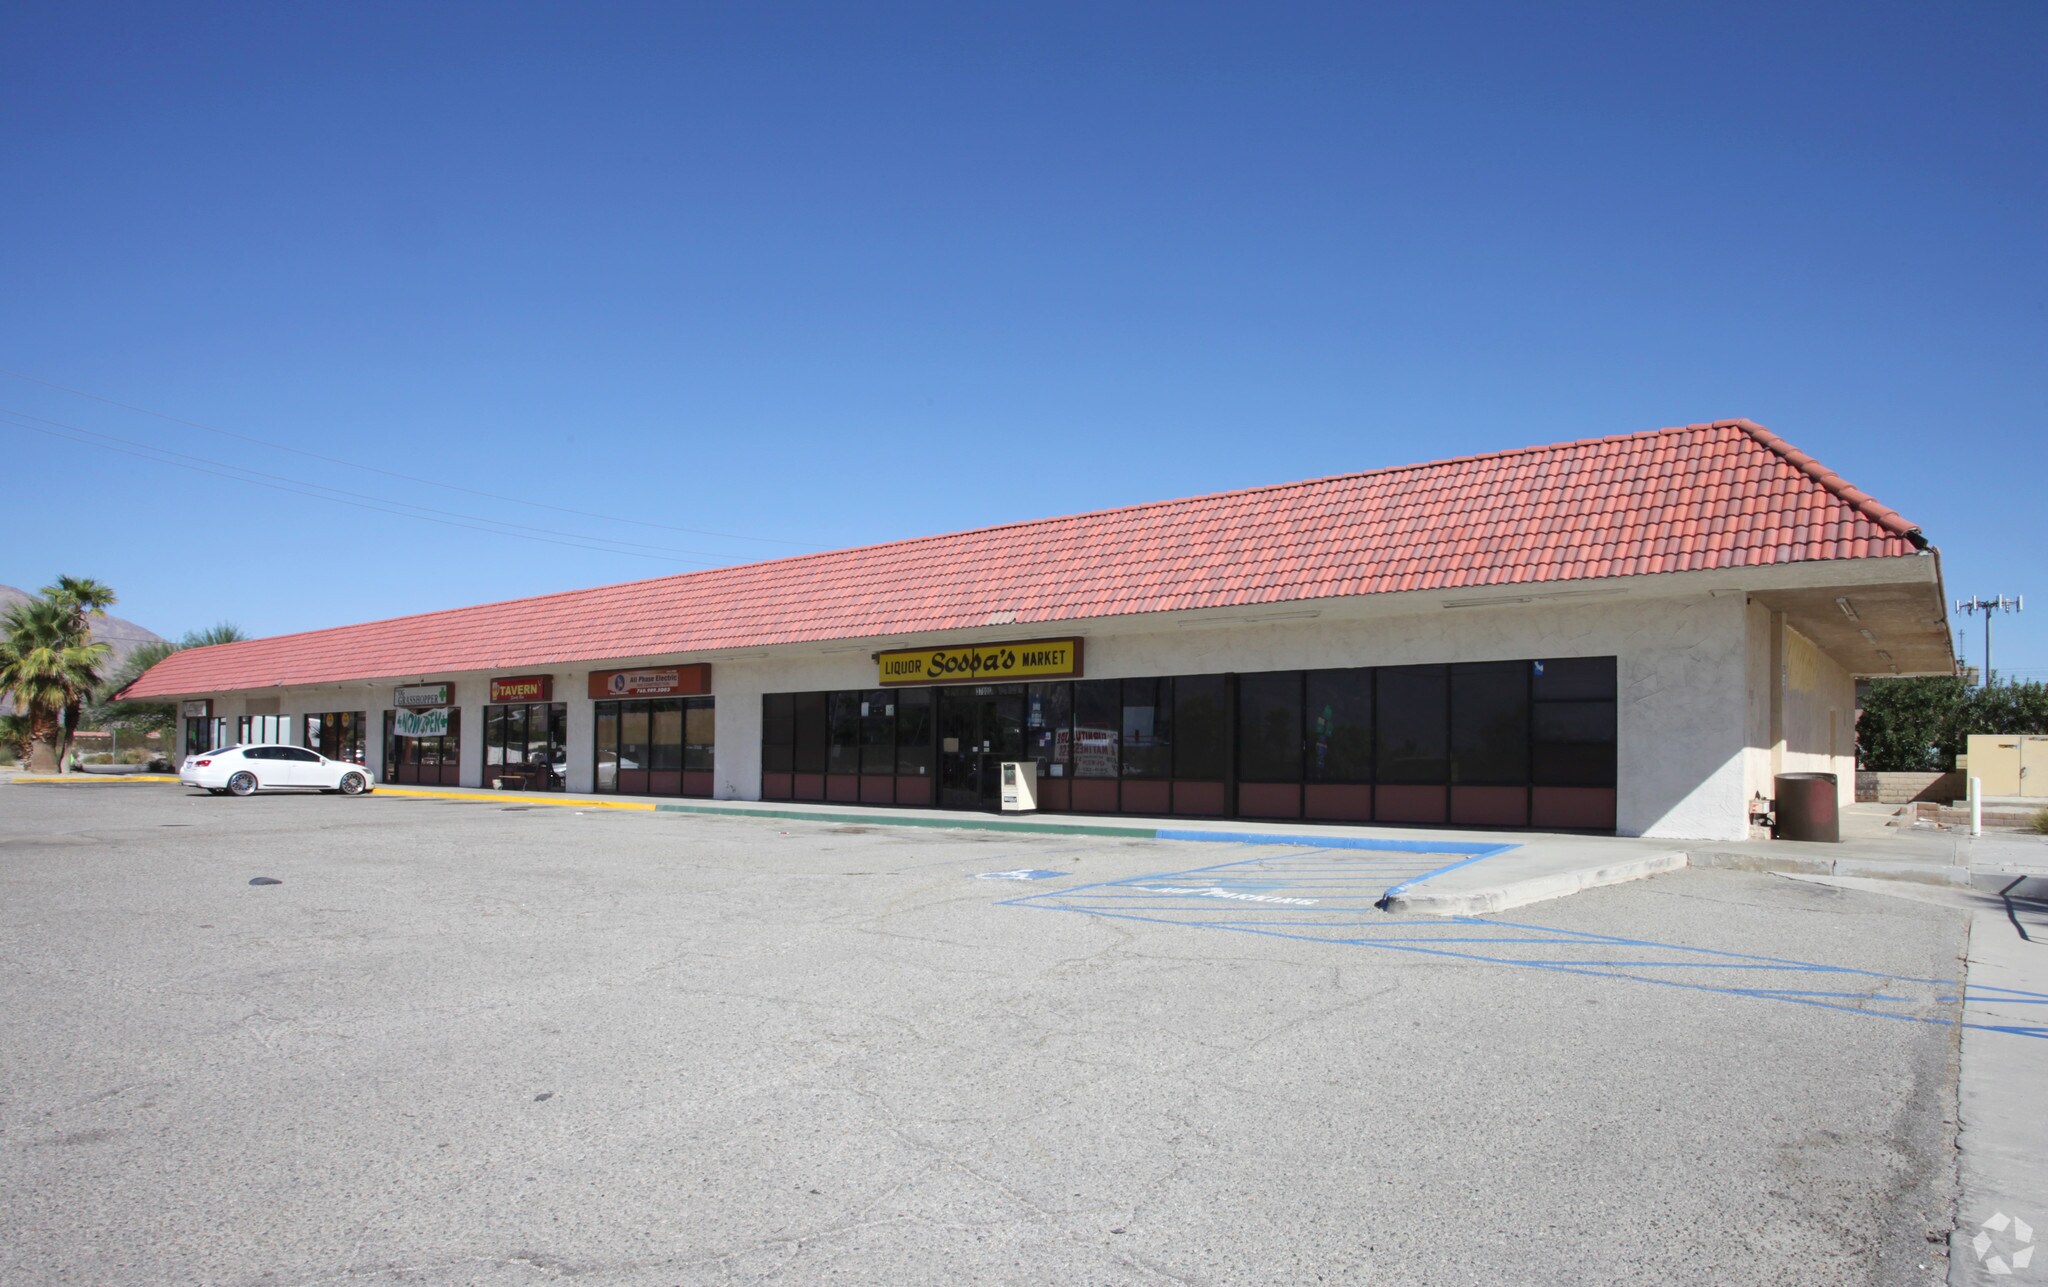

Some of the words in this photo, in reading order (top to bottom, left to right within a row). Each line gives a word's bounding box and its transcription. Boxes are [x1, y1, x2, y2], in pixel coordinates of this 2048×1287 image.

[885, 659, 922, 675] LIQUOR
[927, 649, 1016, 678] Sossa's
[1022, 650, 1066, 667] MARKET
[500, 684, 538, 696] TAVERN
[398, 694, 439, 705] GRASSHOPPER
[401, 712, 422, 734] NOW
